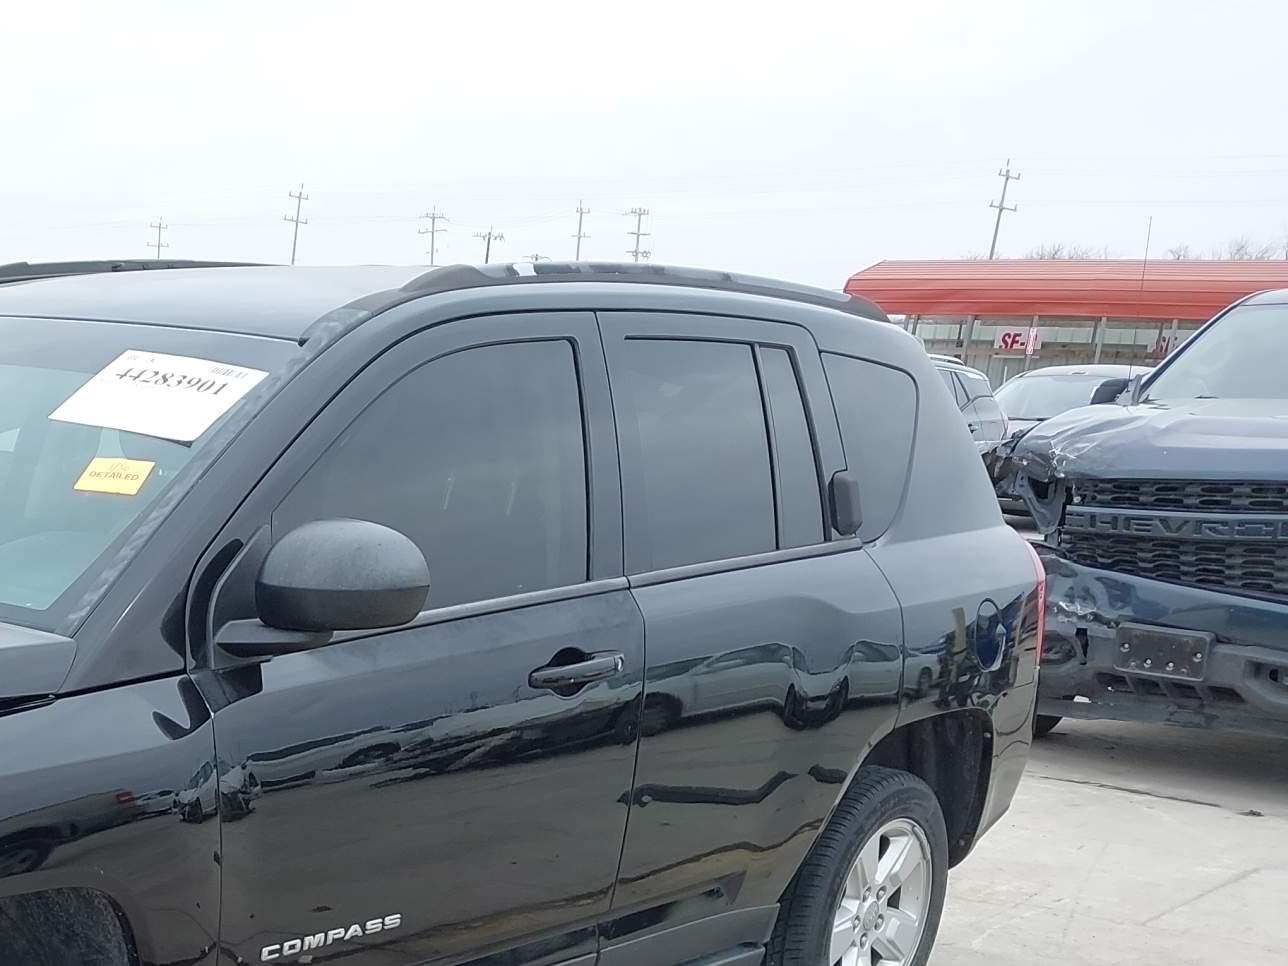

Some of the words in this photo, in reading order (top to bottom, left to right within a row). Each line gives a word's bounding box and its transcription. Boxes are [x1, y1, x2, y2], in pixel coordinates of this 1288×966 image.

[1000, 332, 1038, 349] SF-
[114, 367, 229, 395] 44283901
[88, 470, 141, 482] DETAILED
[1064, 511, 1288, 539] CHEVRO
[260, 913, 402, 962] COMPASS
